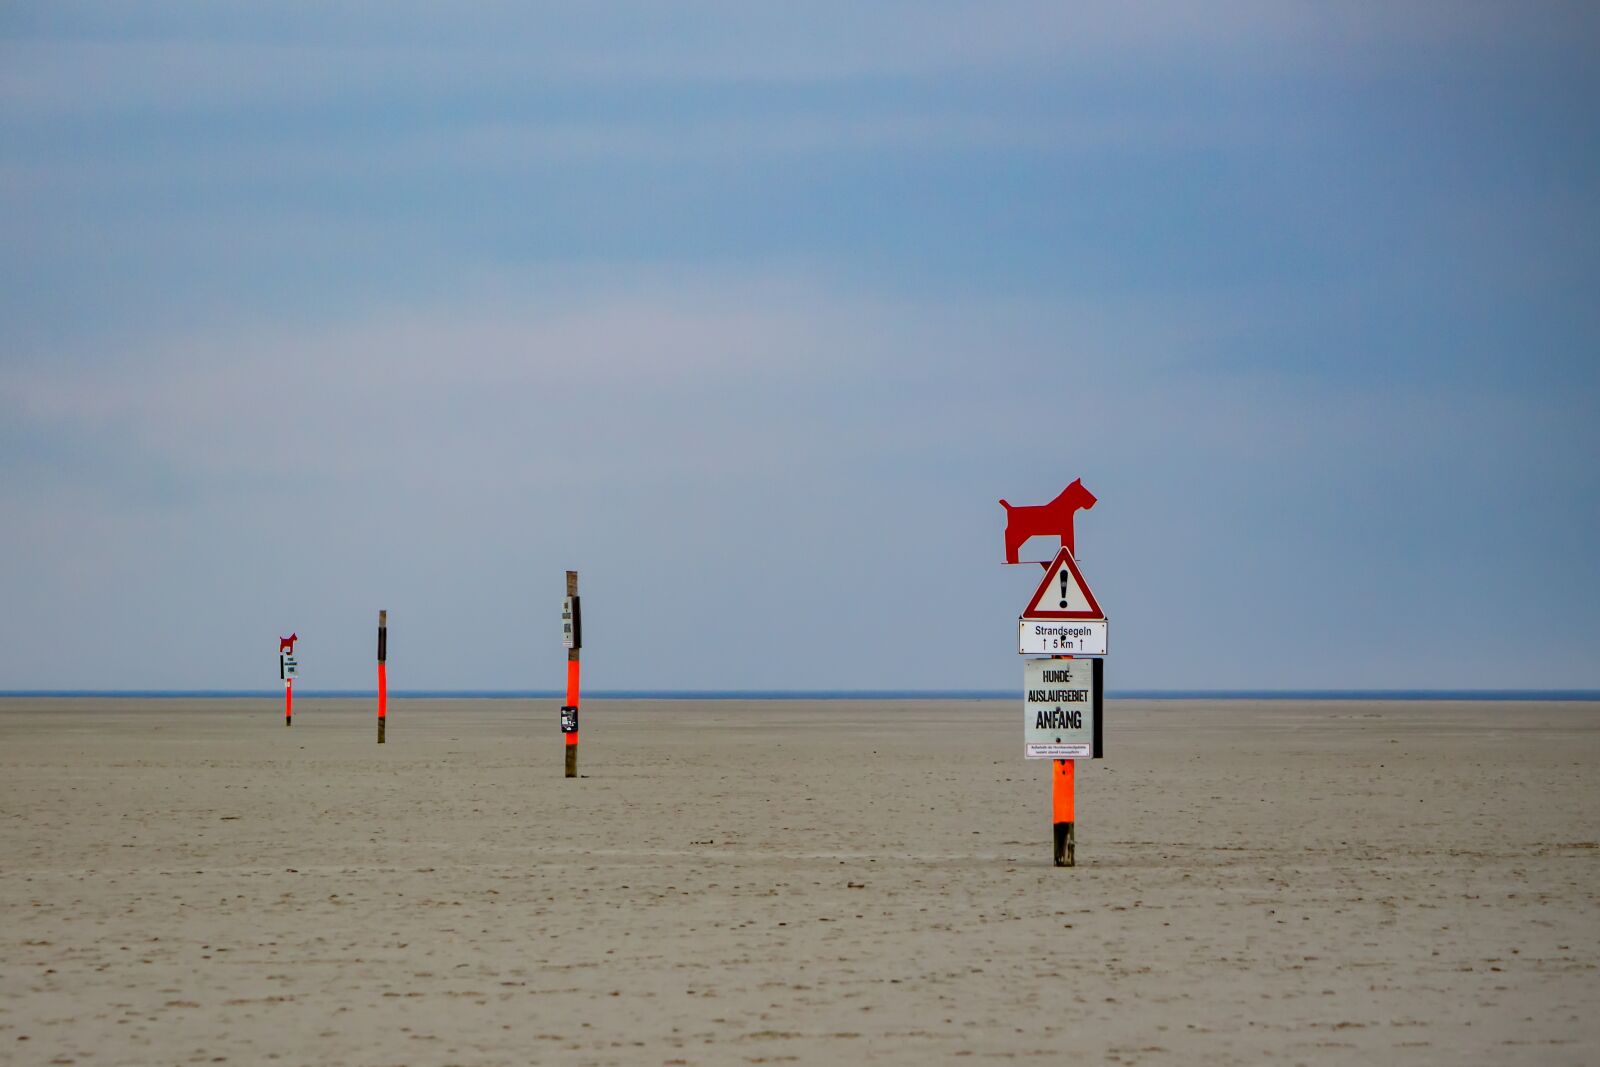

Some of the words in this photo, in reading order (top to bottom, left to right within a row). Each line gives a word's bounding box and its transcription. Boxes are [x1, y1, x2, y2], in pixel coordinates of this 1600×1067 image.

[1035, 625, 1092, 638] Strandsegeln
[1053, 639, 1058, 649] 5
[1060, 639, 1074, 649] km
[1042, 670, 1073, 683] HUNDE-
[1028, 689, 1088, 702] AUSLAUFGEBIET
[1036, 710, 1082, 729] ANFANG
